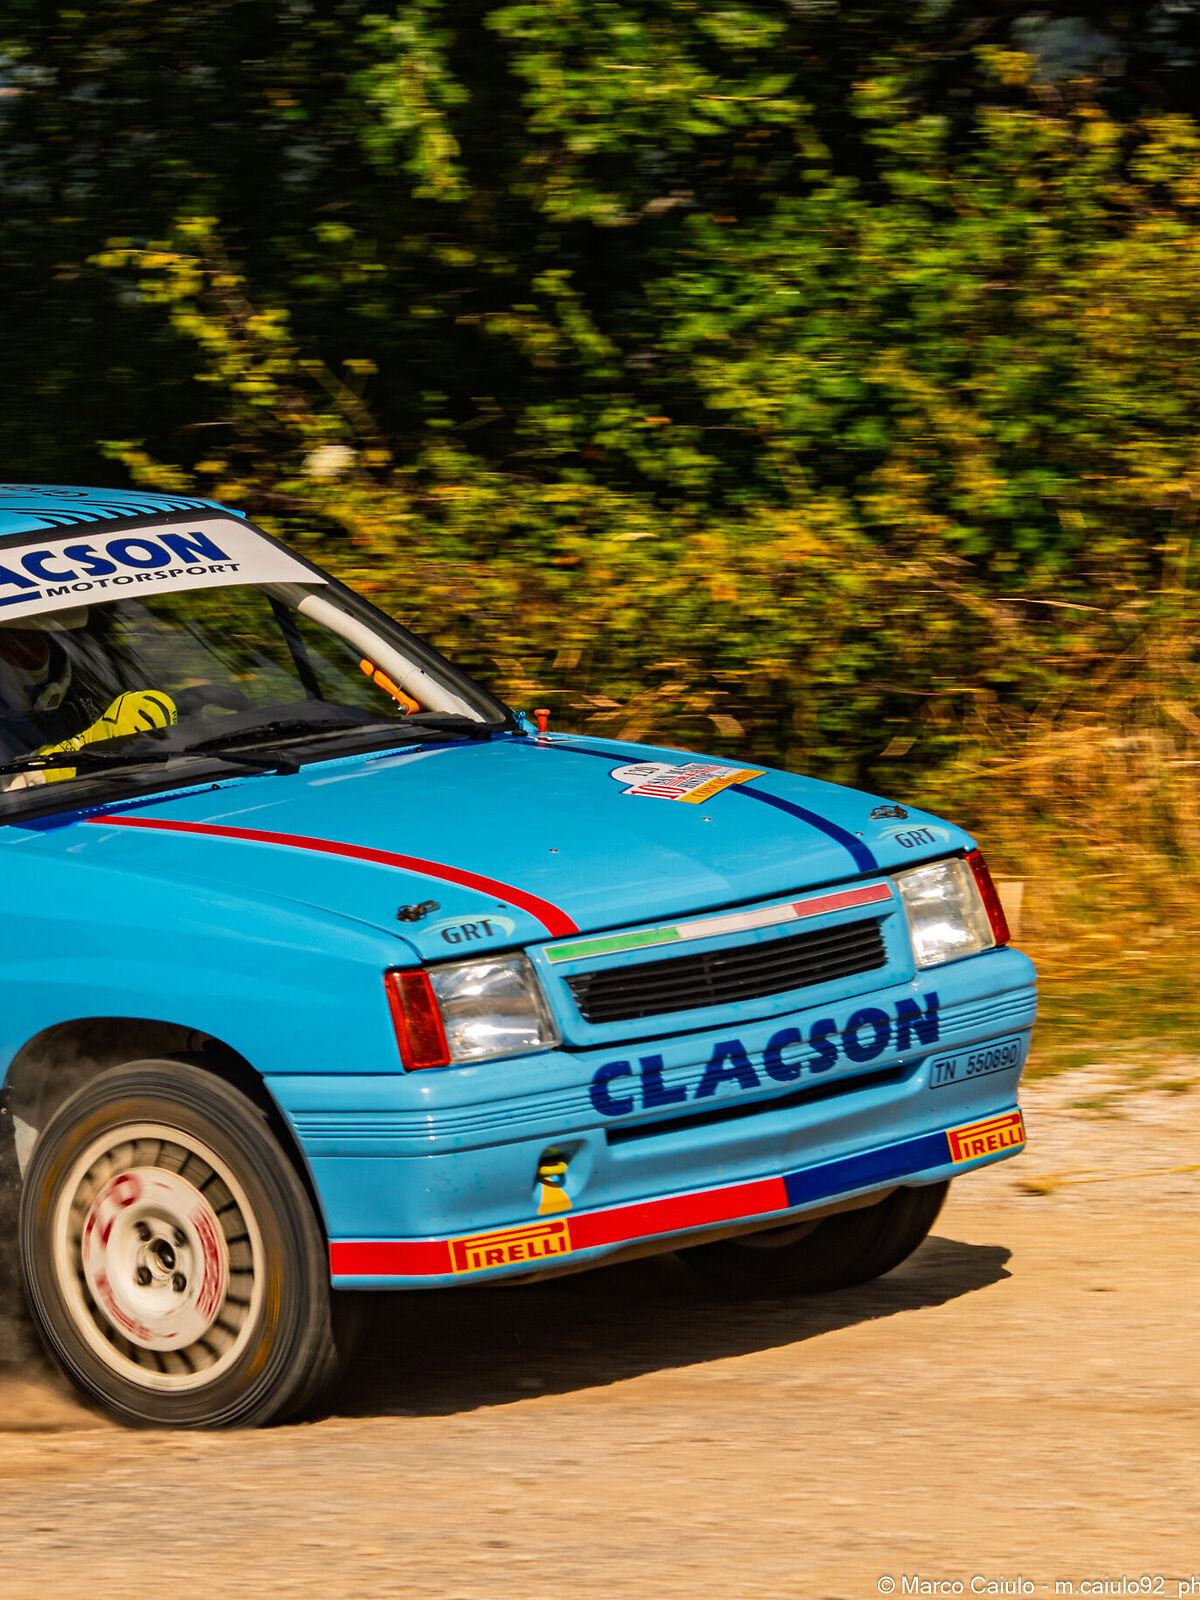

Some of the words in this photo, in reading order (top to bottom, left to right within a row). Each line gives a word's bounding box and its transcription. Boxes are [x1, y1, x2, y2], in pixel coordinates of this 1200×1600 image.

[45, 563, 240, 597] MOTORSPORT
[894, 827, 937, 849] GRT
[441, 919, 496, 945] GRT
[589, 990, 940, 1117] CLACSON
[935, 1059, 957, 1083] TN
[966, 1044, 1018, 1075] 550890
[948, 1113, 1023, 1161] PIRELLI
[452, 1221, 567, 1271] PIRELLI
